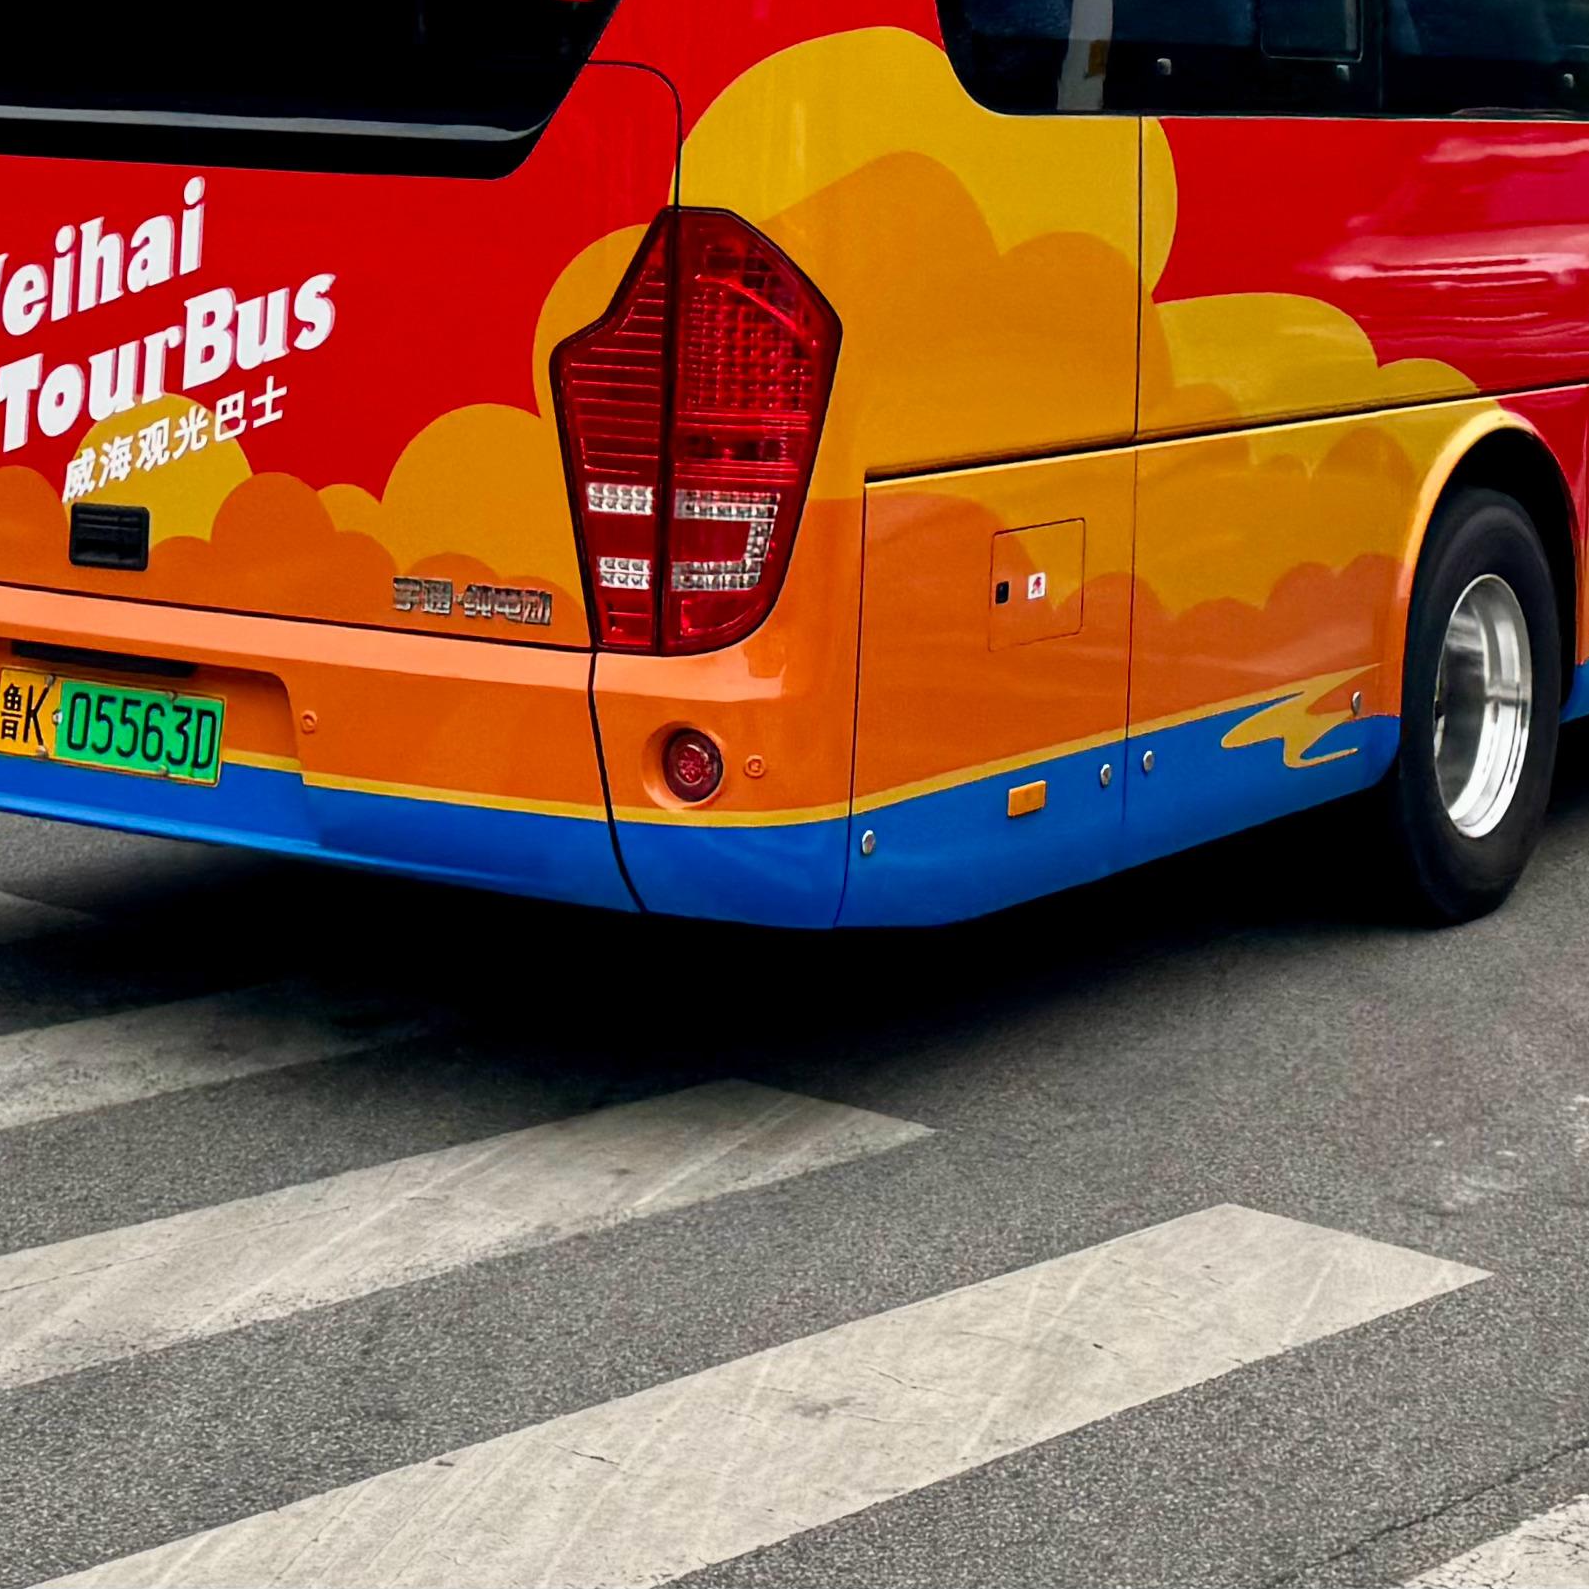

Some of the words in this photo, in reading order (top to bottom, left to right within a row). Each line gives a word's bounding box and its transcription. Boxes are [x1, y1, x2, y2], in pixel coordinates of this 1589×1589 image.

[62, 375, 288, 504] 威海观光巴士
